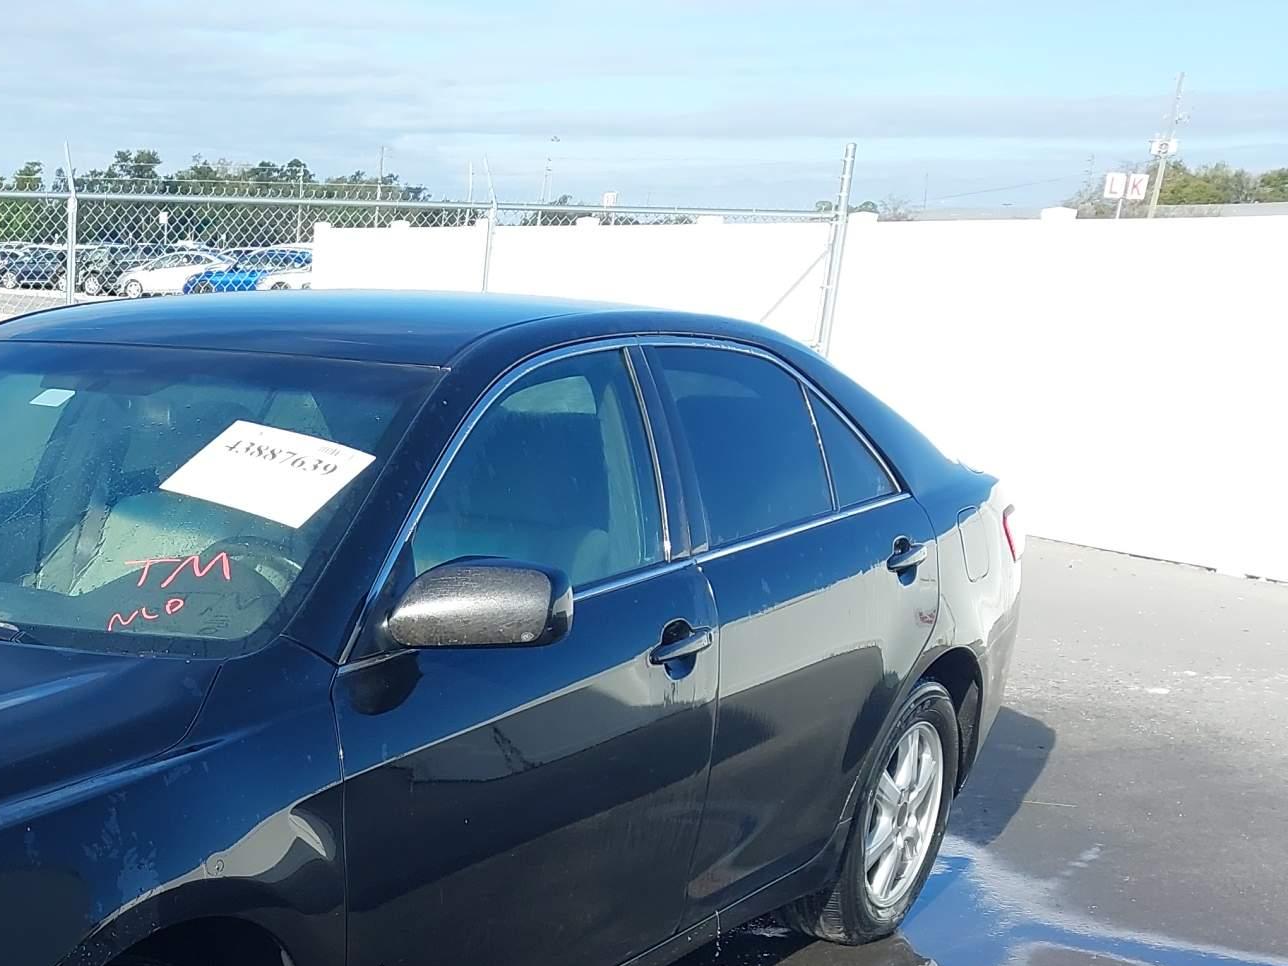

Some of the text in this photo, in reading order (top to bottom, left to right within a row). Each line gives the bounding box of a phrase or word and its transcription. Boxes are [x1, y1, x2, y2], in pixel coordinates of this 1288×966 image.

[1109, 176, 1119, 195] L
[1130, 177, 1144, 196] K
[224, 440, 339, 476] 43887639
[124, 551, 231, 588] TM
